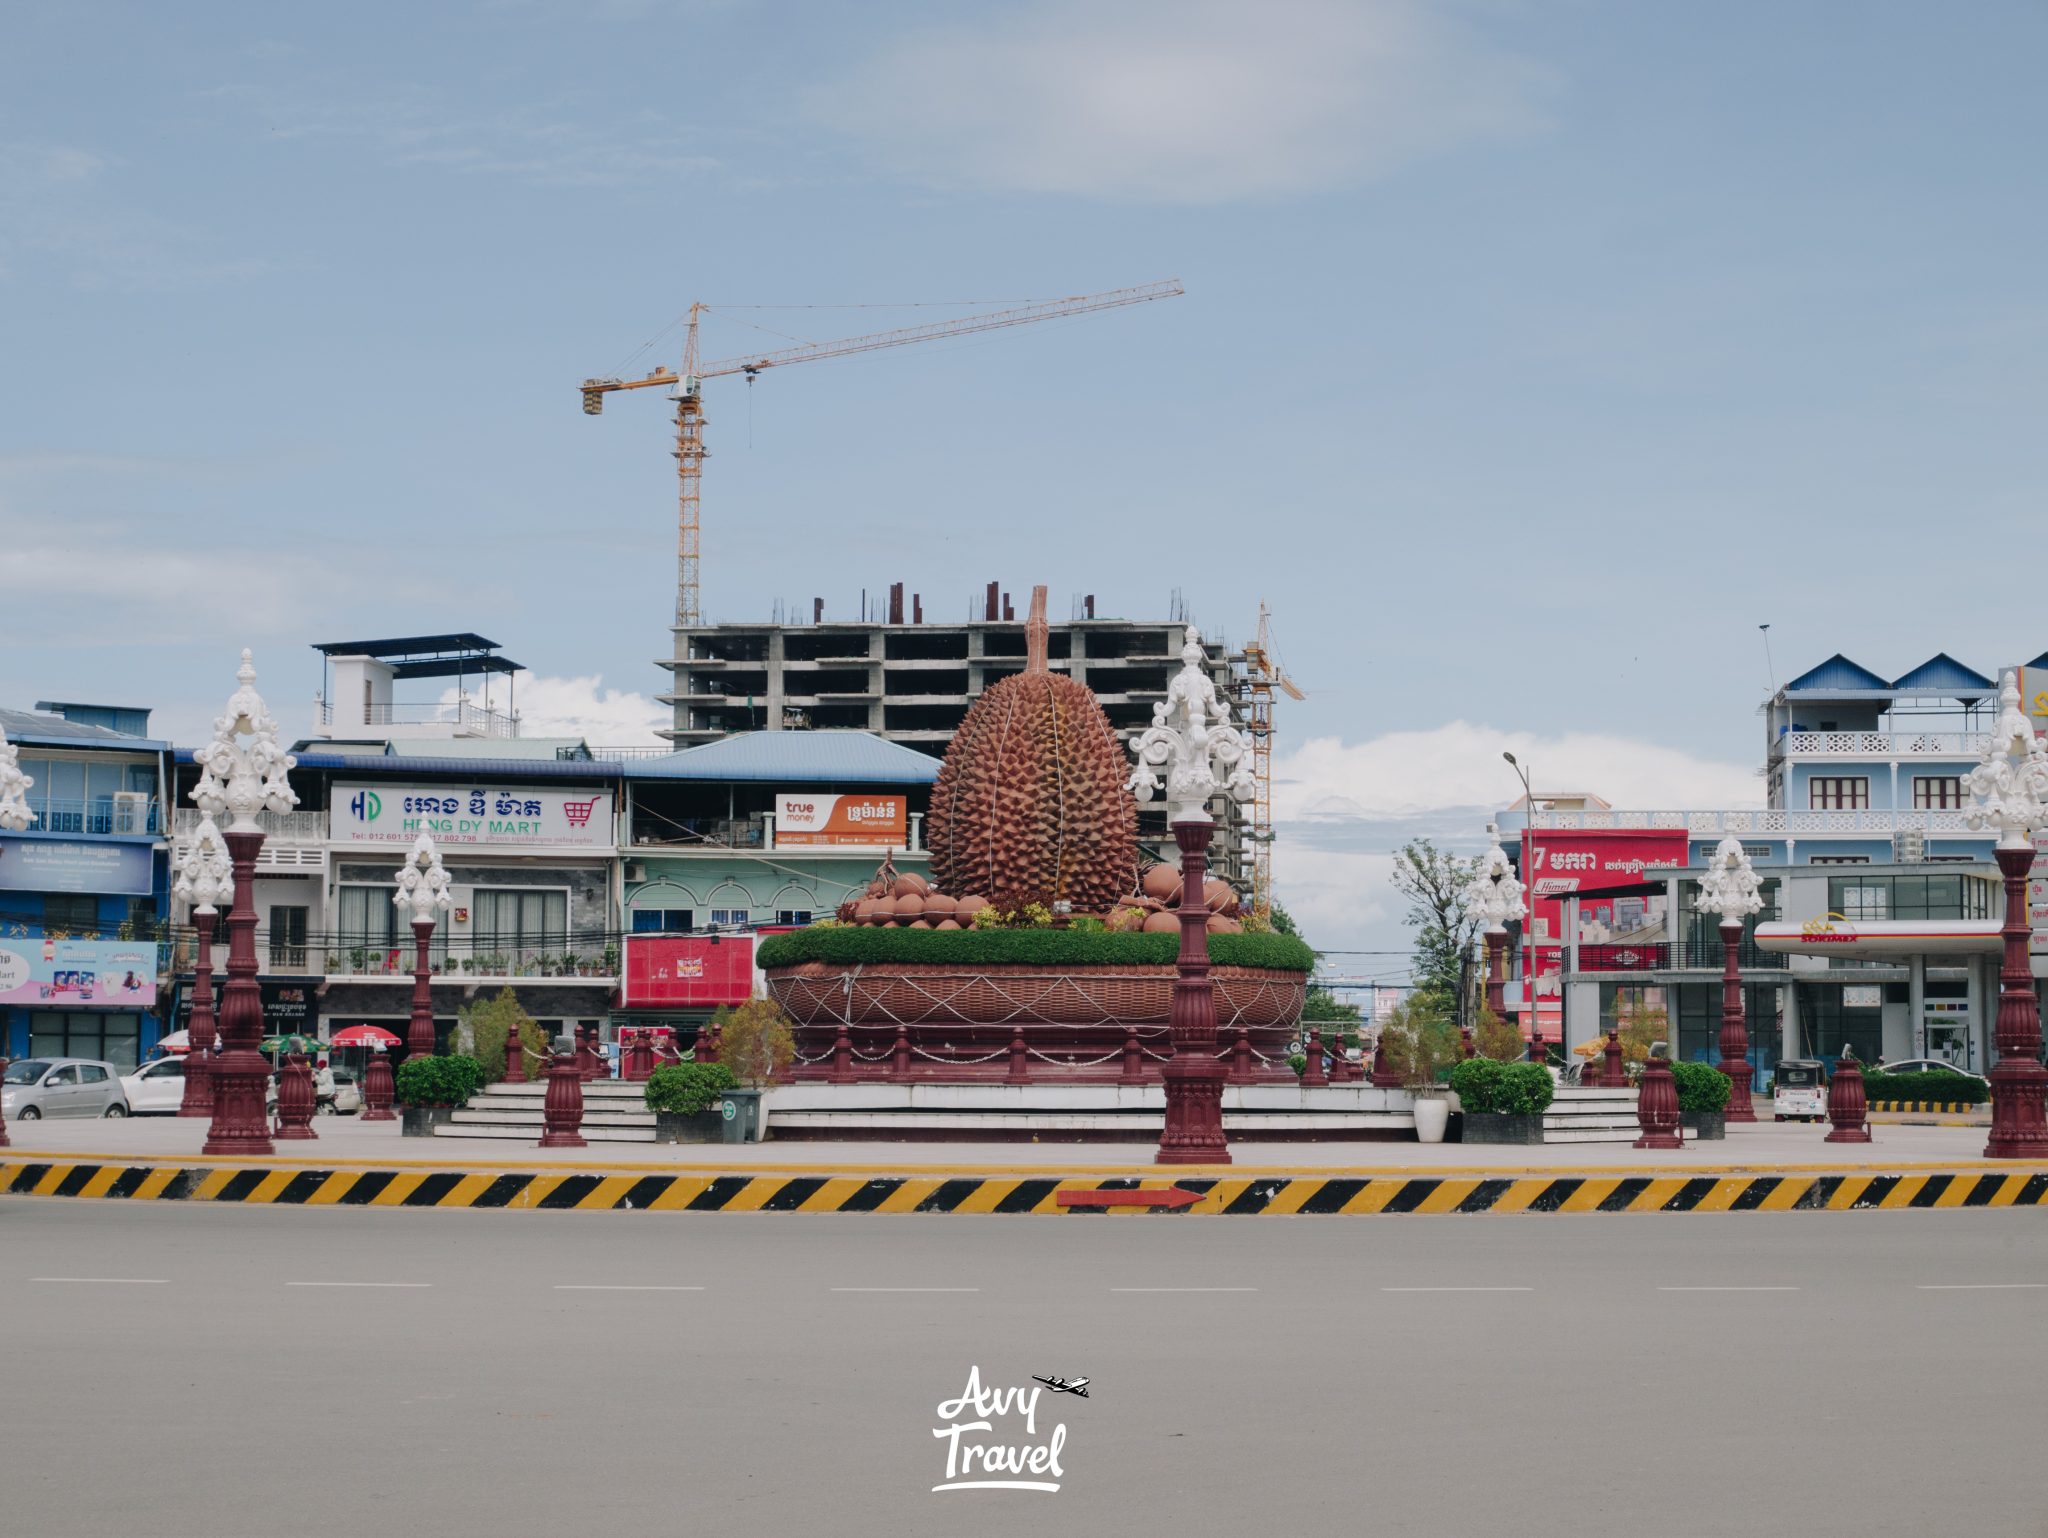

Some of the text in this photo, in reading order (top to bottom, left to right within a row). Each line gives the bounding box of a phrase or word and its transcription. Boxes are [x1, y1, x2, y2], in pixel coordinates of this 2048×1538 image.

[351, 791, 381, 820] HD
[786, 801, 814, 813] true
[787, 814, 815, 823] money
[460, 820, 482, 832] DY
[489, 821, 542, 834] MART
[351, 832, 366, 840] Tel:
[1533, 848, 1546, 870] 7
[1550, 853, 1596, 870] មករា
[1541, 881, 1571, 893] Himel
[1801, 934, 1857, 943] SOKIMEX
[0, 970, 15, 979] art
